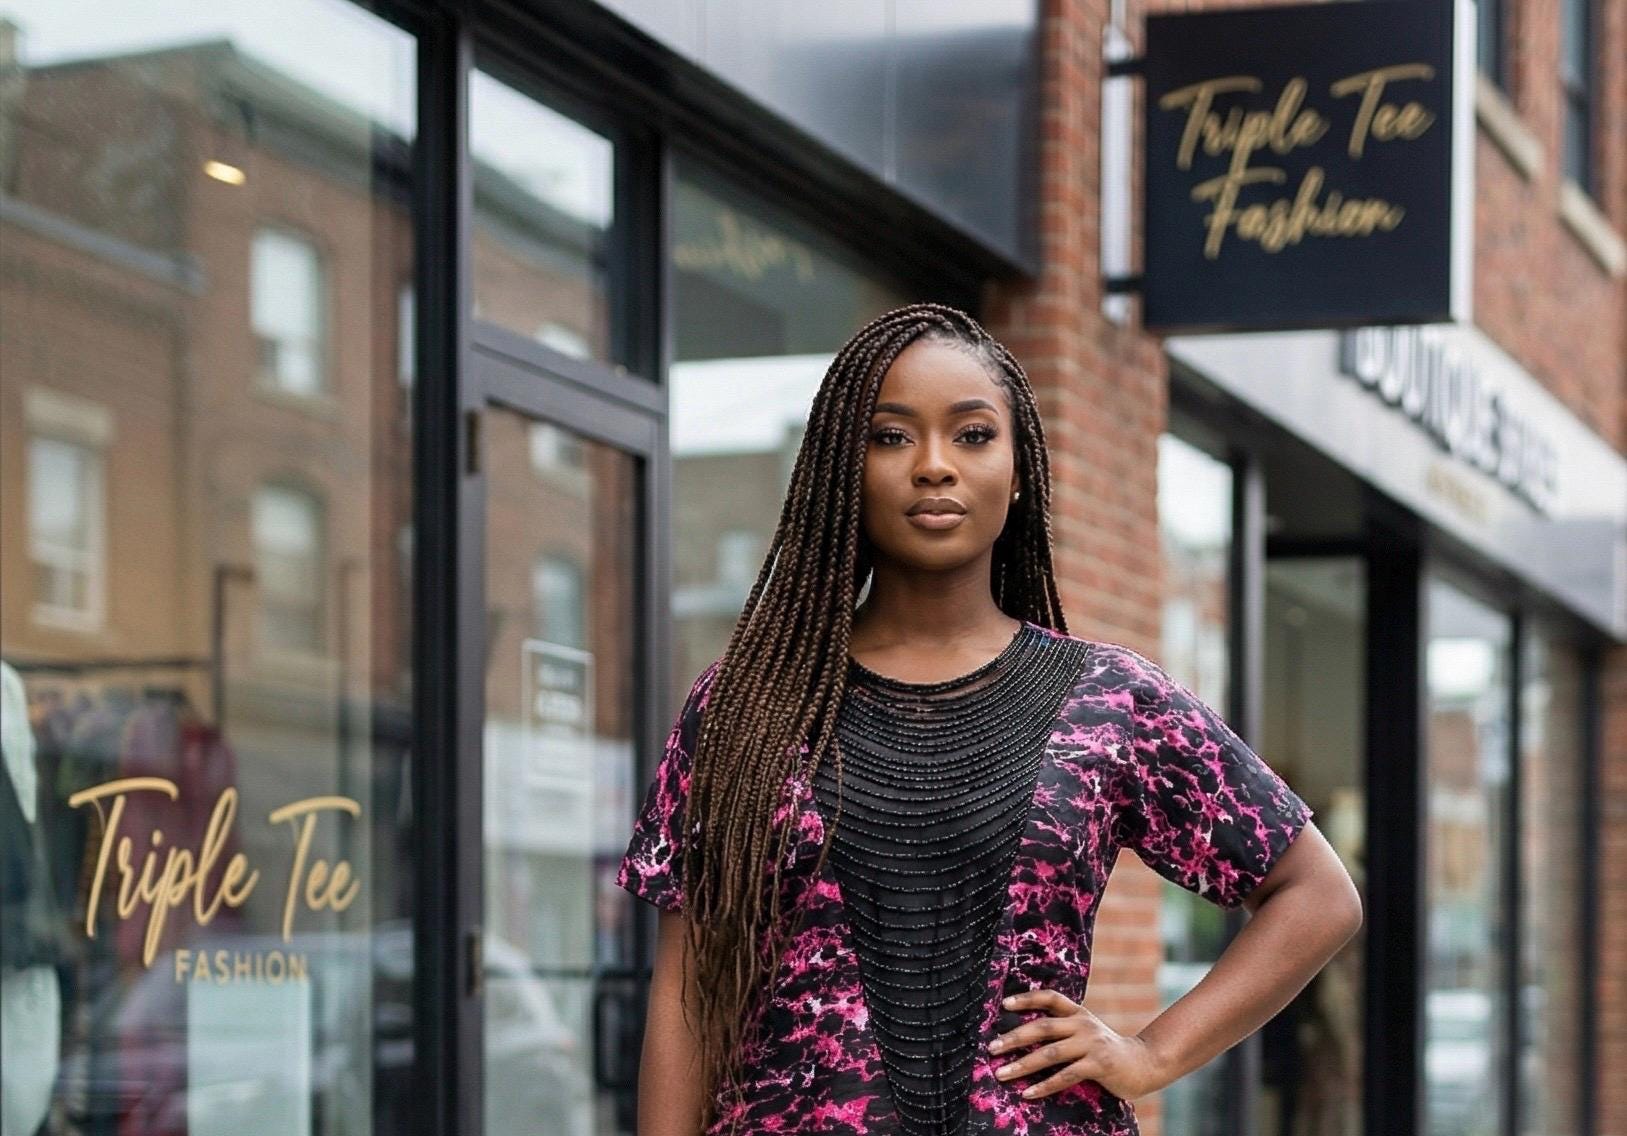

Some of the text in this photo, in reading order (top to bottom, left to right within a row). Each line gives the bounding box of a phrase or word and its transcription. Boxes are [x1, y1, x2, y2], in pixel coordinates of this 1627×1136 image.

[1160, 63, 1436, 178] Triple Tee
[1191, 166, 1404, 260] Fashion
[68, 776, 361, 968] Triple Tee
[174, 948, 309, 986] FASHION
